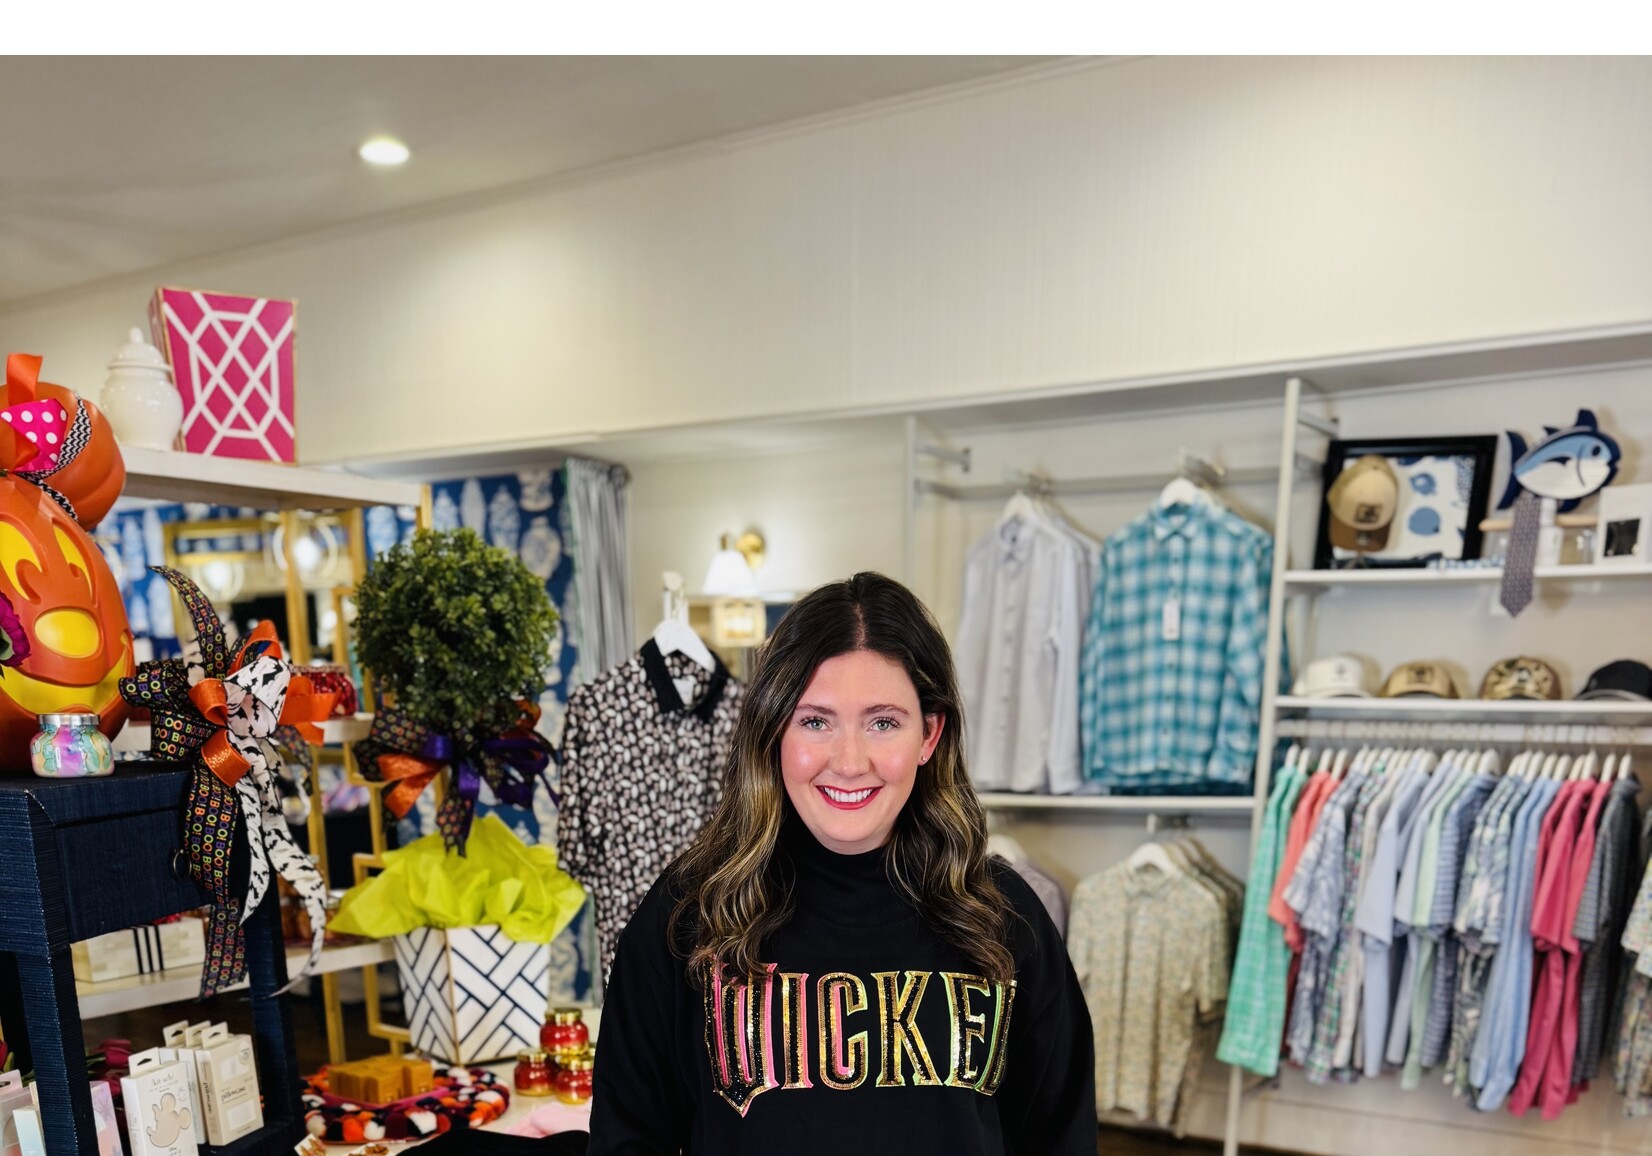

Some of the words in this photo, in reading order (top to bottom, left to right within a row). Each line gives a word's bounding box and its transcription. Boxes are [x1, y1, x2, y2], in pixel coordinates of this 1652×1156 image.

[191, 807, 206, 836] BOO!
[205, 800, 220, 827] BOO!
[216, 813, 231, 841] BOO!
